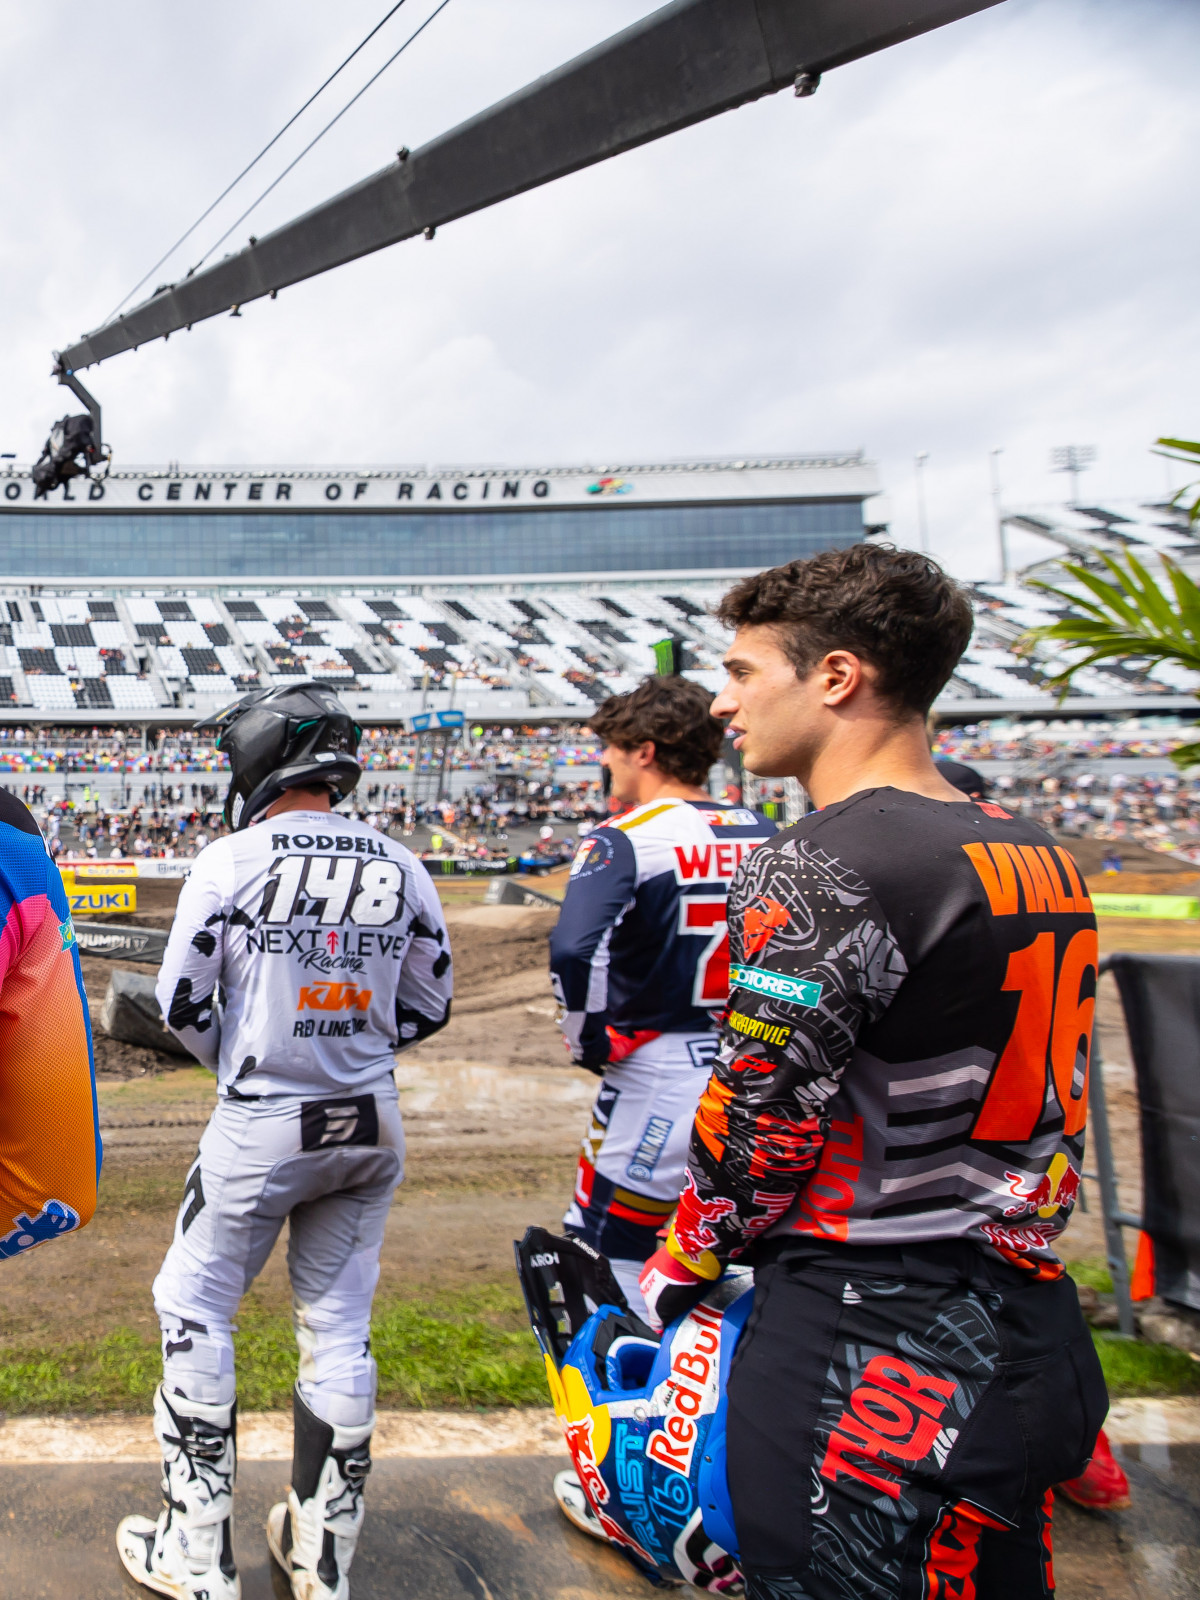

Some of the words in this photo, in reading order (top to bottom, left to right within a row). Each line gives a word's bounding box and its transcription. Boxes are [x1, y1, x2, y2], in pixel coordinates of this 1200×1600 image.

[138, 482, 293, 501] CENTER
[325, 482, 368, 501] OF
[397, 480, 550, 501] RACING
[272, 834, 388, 857] RODBELL
[67, 892, 131, 910] ZUKI
[264, 854, 405, 927] 148
[961, 842, 1095, 917] VIALL
[246, 929, 322, 954] NEXT
[298, 949, 368, 975] Racing
[297, 981, 373, 1011] KTM
[317, 1020, 350, 1037] LINE
[971, 930, 1099, 1142] 16
[635, 1117, 672, 1167] YAMAHA
[672, 1303, 724, 1385] Bull
[650, 1379, 702, 1474] Red
[819, 1355, 958, 1500] THOR
[615, 1423, 672, 1570] TRUST
